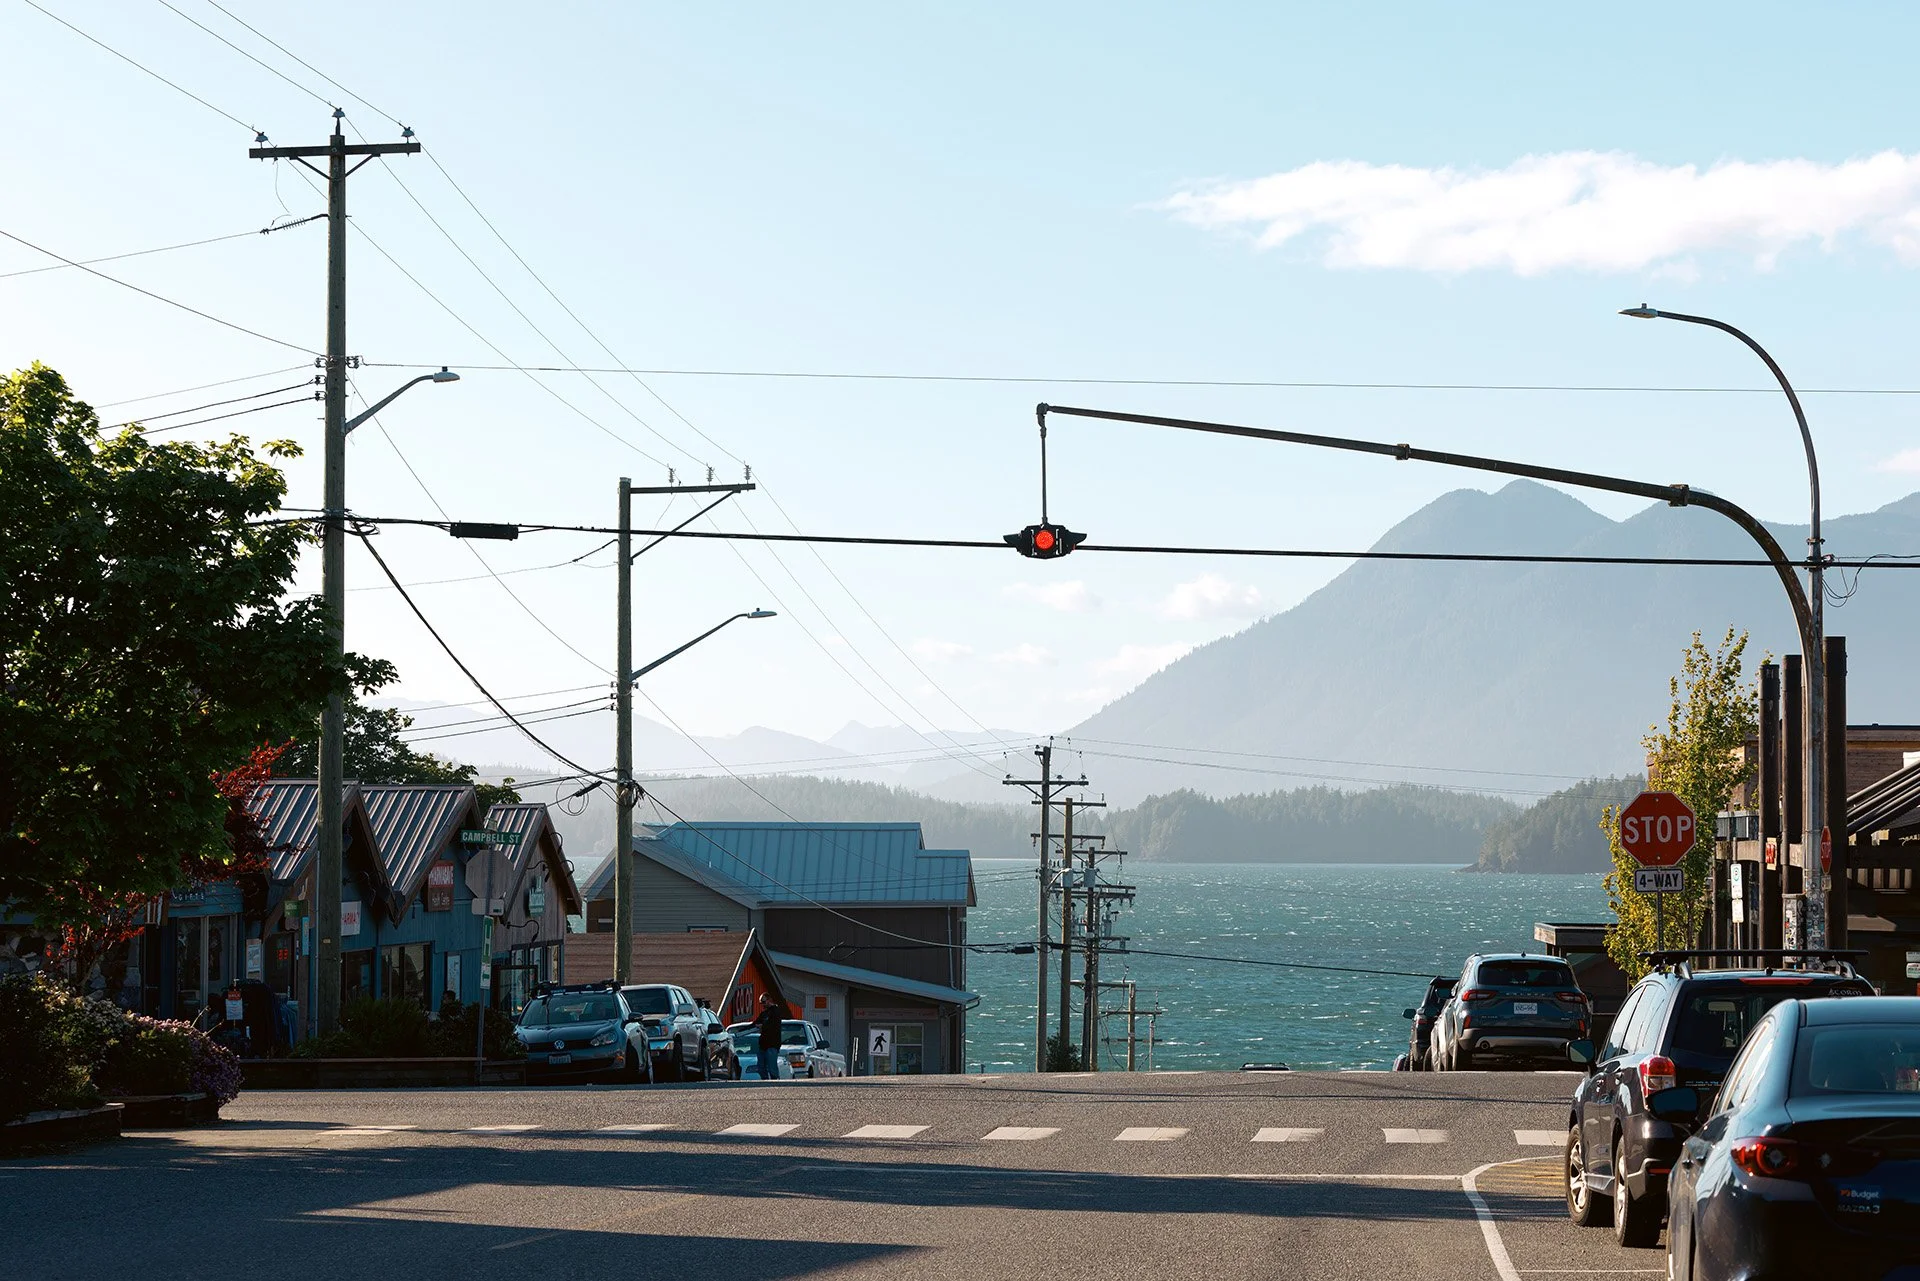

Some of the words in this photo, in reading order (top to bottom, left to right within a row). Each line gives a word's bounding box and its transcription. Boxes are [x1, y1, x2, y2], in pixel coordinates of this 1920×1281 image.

[1624, 815, 1692, 844] STOP
[462, 831, 505, 843] CAMPBELL
[509, 834, 520, 844] ST
[1639, 873, 1679, 888] 4-WAY
[1851, 1190, 1879, 1200] Budget
